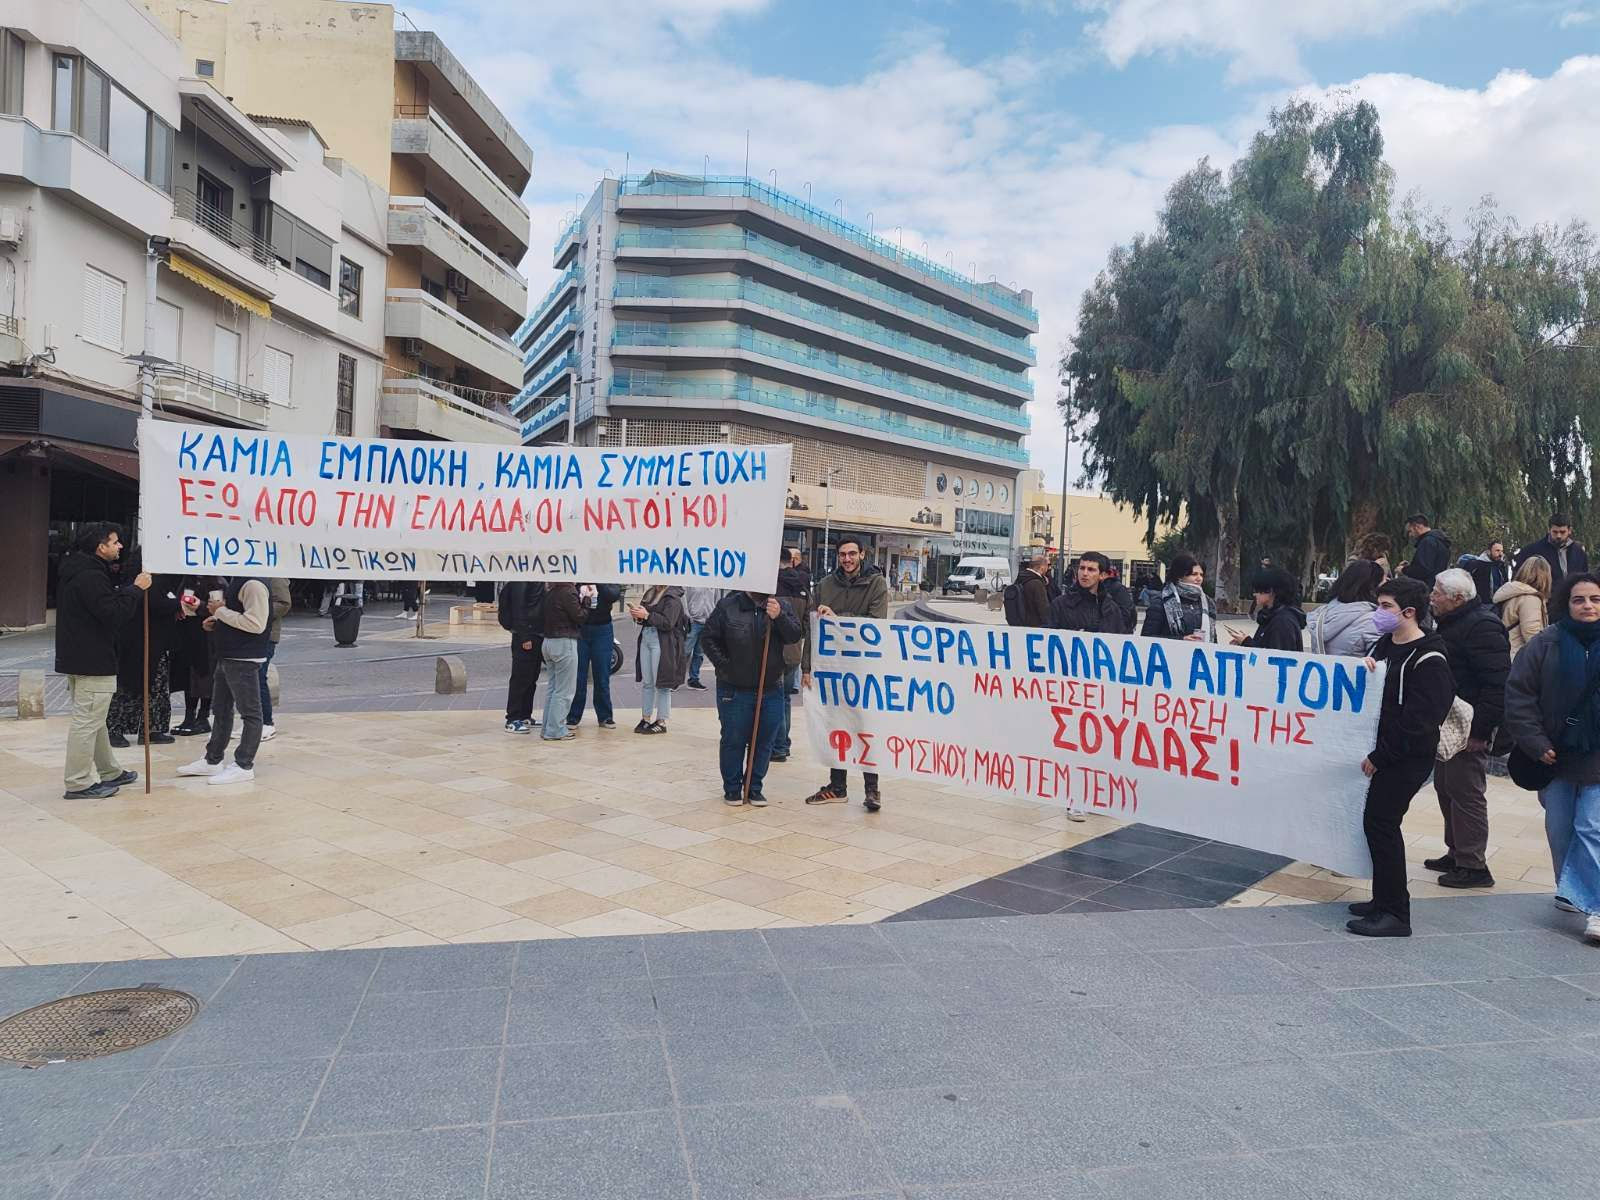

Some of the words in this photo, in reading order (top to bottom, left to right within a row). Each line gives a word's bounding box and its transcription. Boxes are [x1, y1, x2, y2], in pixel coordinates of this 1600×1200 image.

[178, 431, 292, 477] ΚΑΜΙΑ
[495, 450, 583, 490] ΚΑΜΙΑ
[597, 449, 767, 490] ΣΥΜΜΕΤΟΧΗ
[178, 477, 241, 521] ΕΞΩ
[254, 486, 317, 527] ΑΠΟ
[335, 491, 395, 529] ΤΗΝ
[410, 495, 525, 533] ΕΛΛΑΔΑ
[536, 498, 562, 534] ΟΙ
[184, 535, 277, 567] ΕΝΩΣΗ
[299, 543, 417, 573] ΙΔΙΩΤΙΚΩΝ
[437, 552, 577, 576] ΥΠΑΛΛΗΛΩΝ
[618, 547, 747, 579] ΗΡΑΚΛΕΙΟΥ
[813, 671, 955, 715] ΠΟΛΕΜΟ
[818, 618, 882, 658] ΕΞΩ
[890, 624, 978, 667] ΤΩΡΑ
[987, 631, 1012, 670] Η
[1026, 633, 1172, 689] ΕΛΛΑΔΑ
[1267, 656, 1367, 714] ΤΟΝ
[973, 672, 1003, 699] ΝΑ
[1011, 676, 1105, 710] ΚΛΕΙΣΕΙ
[1121, 687, 1140, 717] Η
[1154, 693, 1228, 736] ΒΑΣΗ
[1246, 704, 1316, 745] ΤΗΣ
[1076, 766, 1138, 813] ΤΕΜΥ
